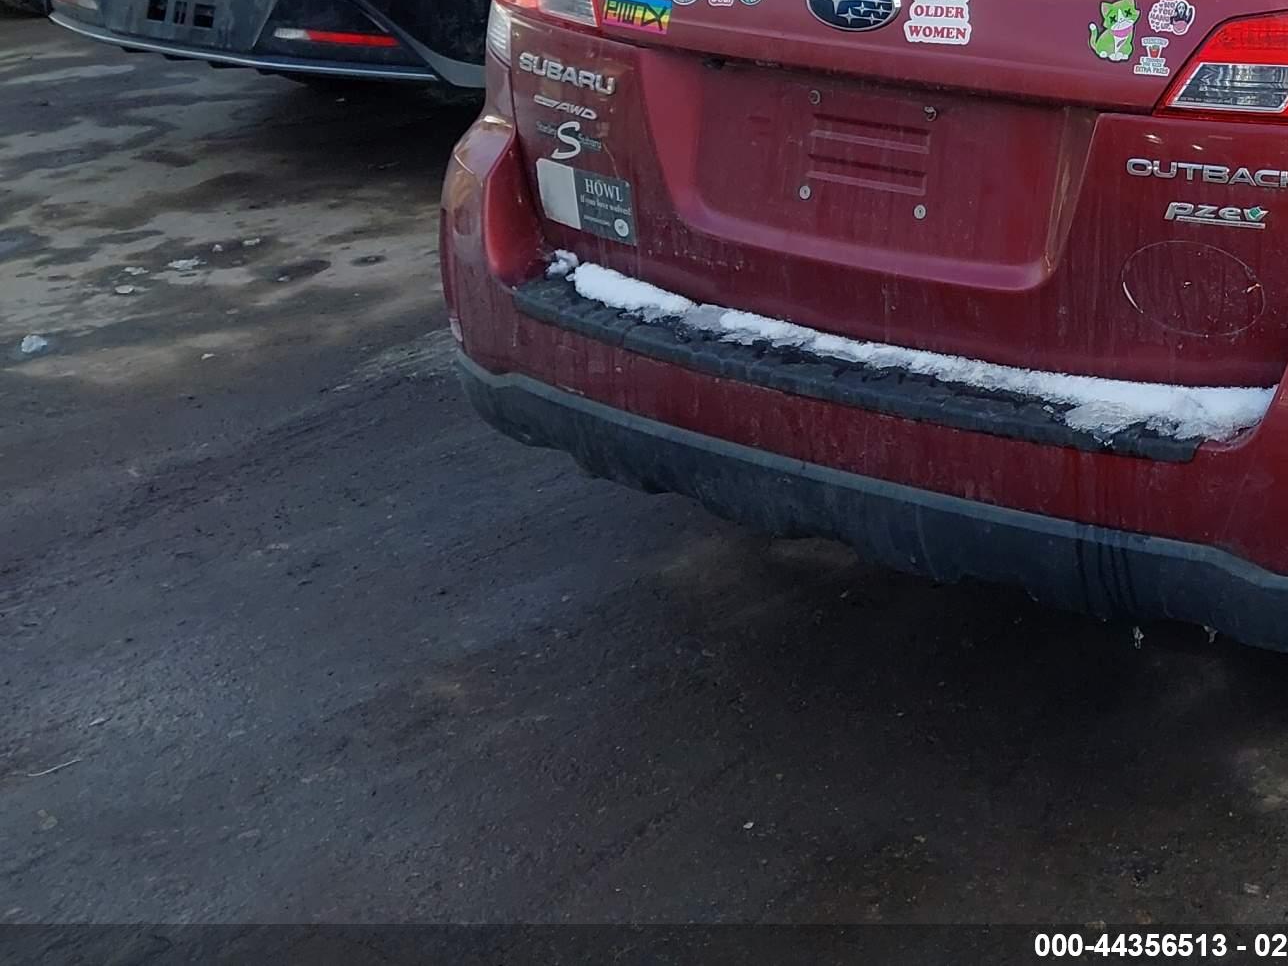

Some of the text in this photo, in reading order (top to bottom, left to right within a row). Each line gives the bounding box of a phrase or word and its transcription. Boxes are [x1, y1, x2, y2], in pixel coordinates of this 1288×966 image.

[913, 5, 965, 18] OLDER
[908, 25, 967, 40] WOMEN
[519, 52, 616, 95] SUBARU
[556, 102, 598, 120] AWD
[584, 178, 623, 202] HOWL
